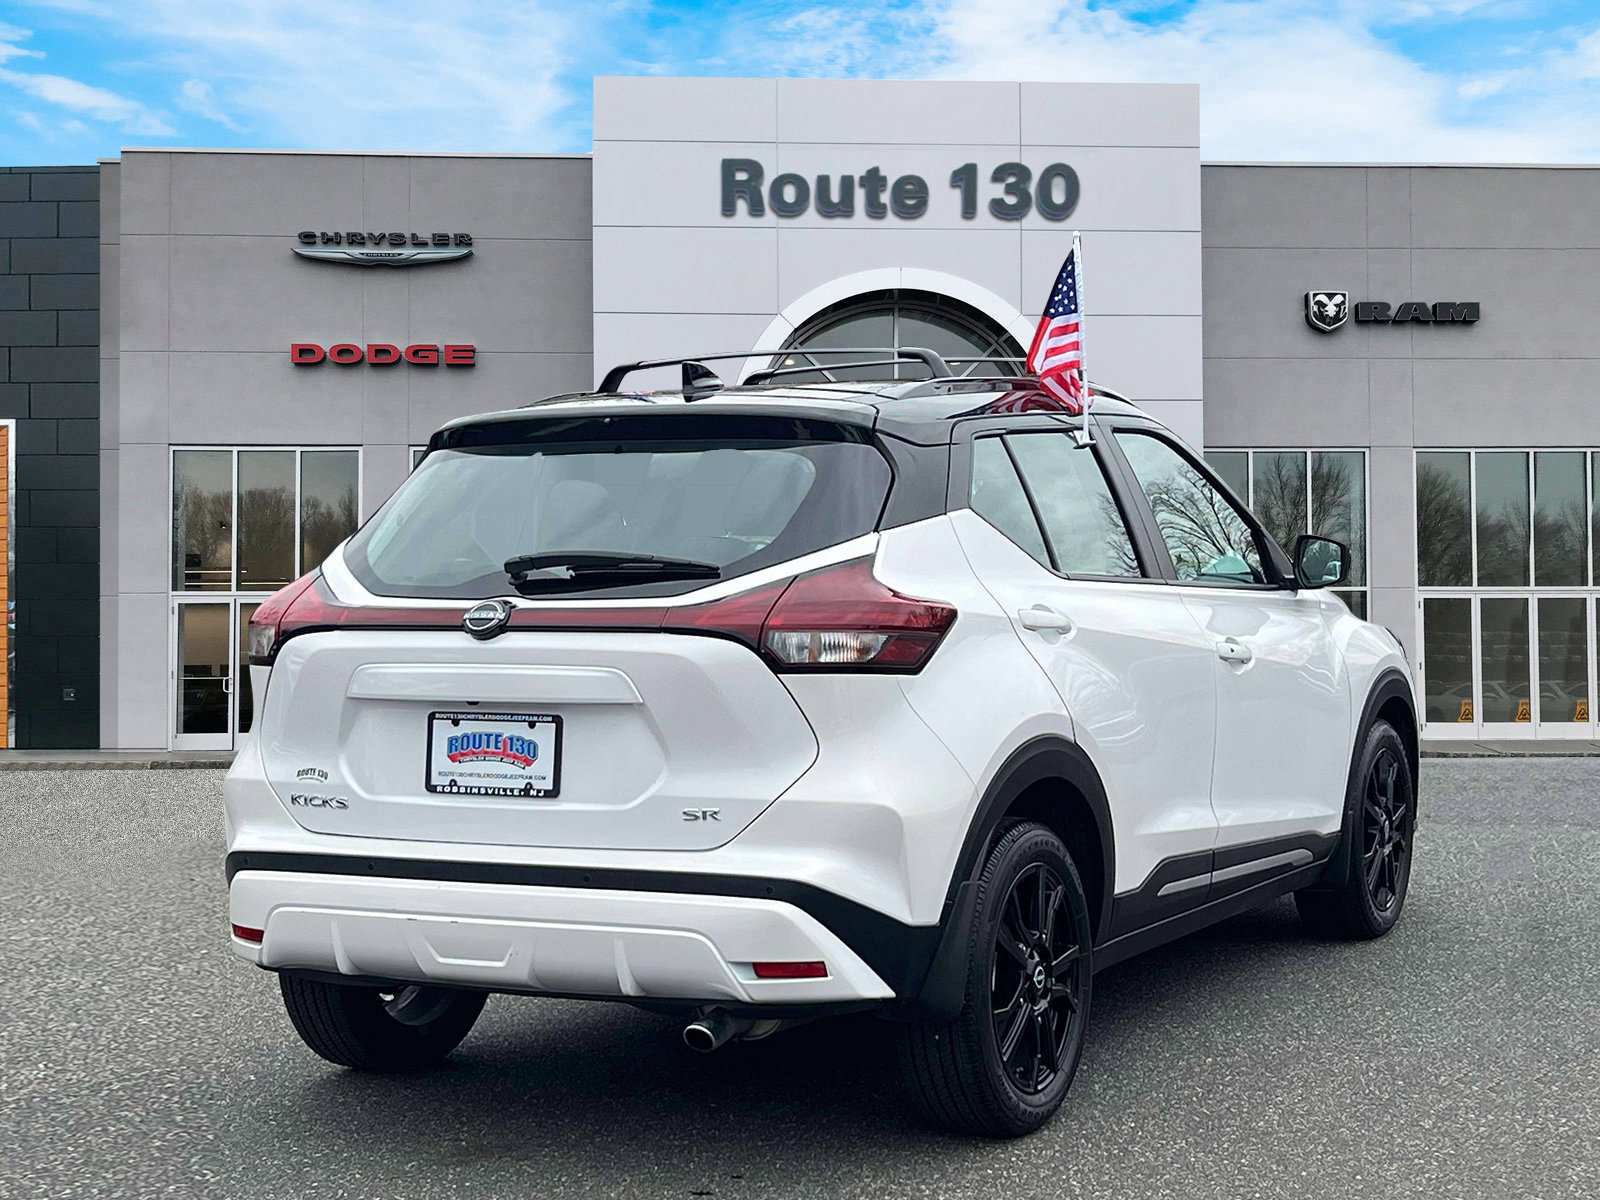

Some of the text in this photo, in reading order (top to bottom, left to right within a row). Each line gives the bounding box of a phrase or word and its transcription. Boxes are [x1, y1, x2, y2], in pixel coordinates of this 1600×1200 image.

[721, 158, 1080, 221] Route 130
[298, 231, 473, 245] CHRYSLER
[1355, 302, 1480, 323] RAM
[291, 343, 475, 365] DODGE
[447, 732, 539, 760] ROUTE 130
[436, 785, 545, 797] ROBBINSVILLE, NJ
[291, 794, 349, 810] KICKS
[682, 807, 721, 821] SR
